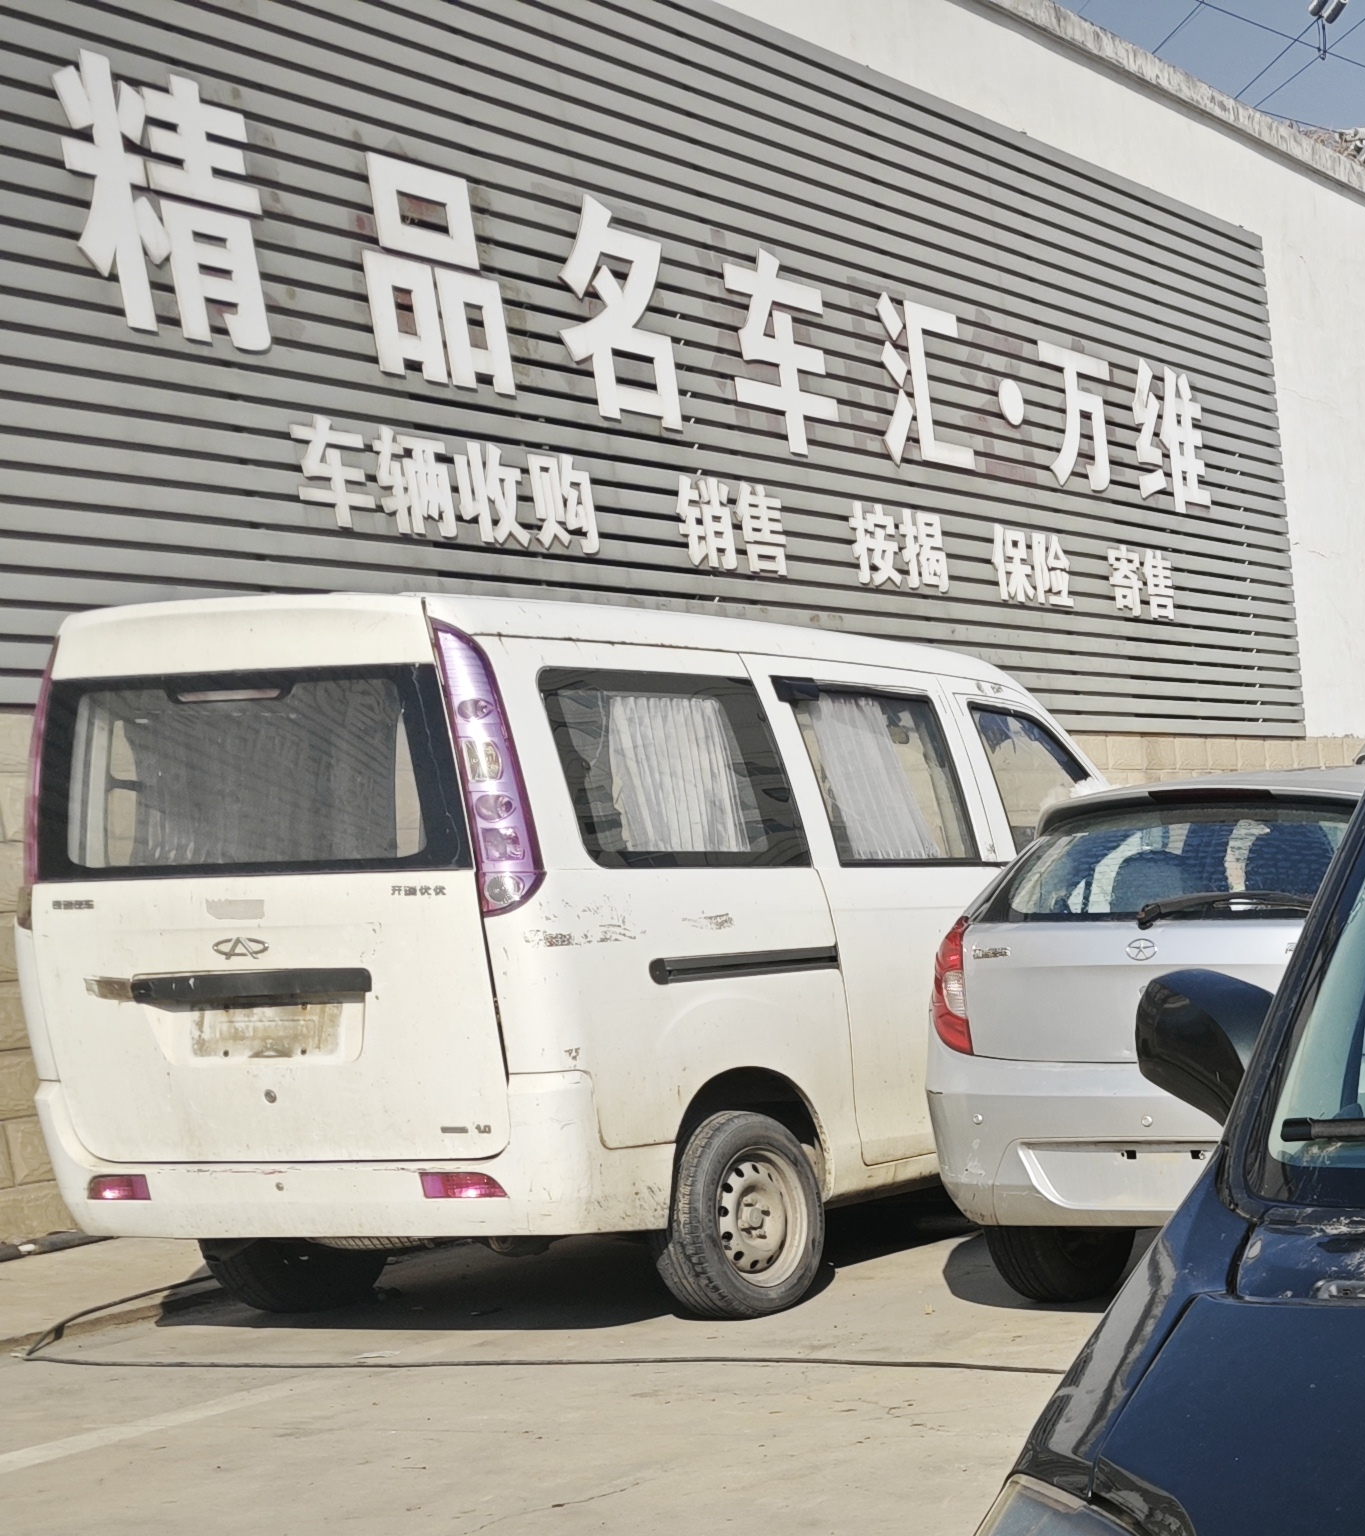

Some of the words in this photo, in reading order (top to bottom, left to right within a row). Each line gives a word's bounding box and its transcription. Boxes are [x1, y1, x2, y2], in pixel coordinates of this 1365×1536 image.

[51, 48, 1211, 513] 精品名车汇·万维
[289, 414, 600, 555] 车辆收购
[677, 475, 787, 577] 销售
[849, 501, 949, 593] 按揭
[991, 523, 1074, 608] 保险
[1107, 544, 1175, 620] 寄售
